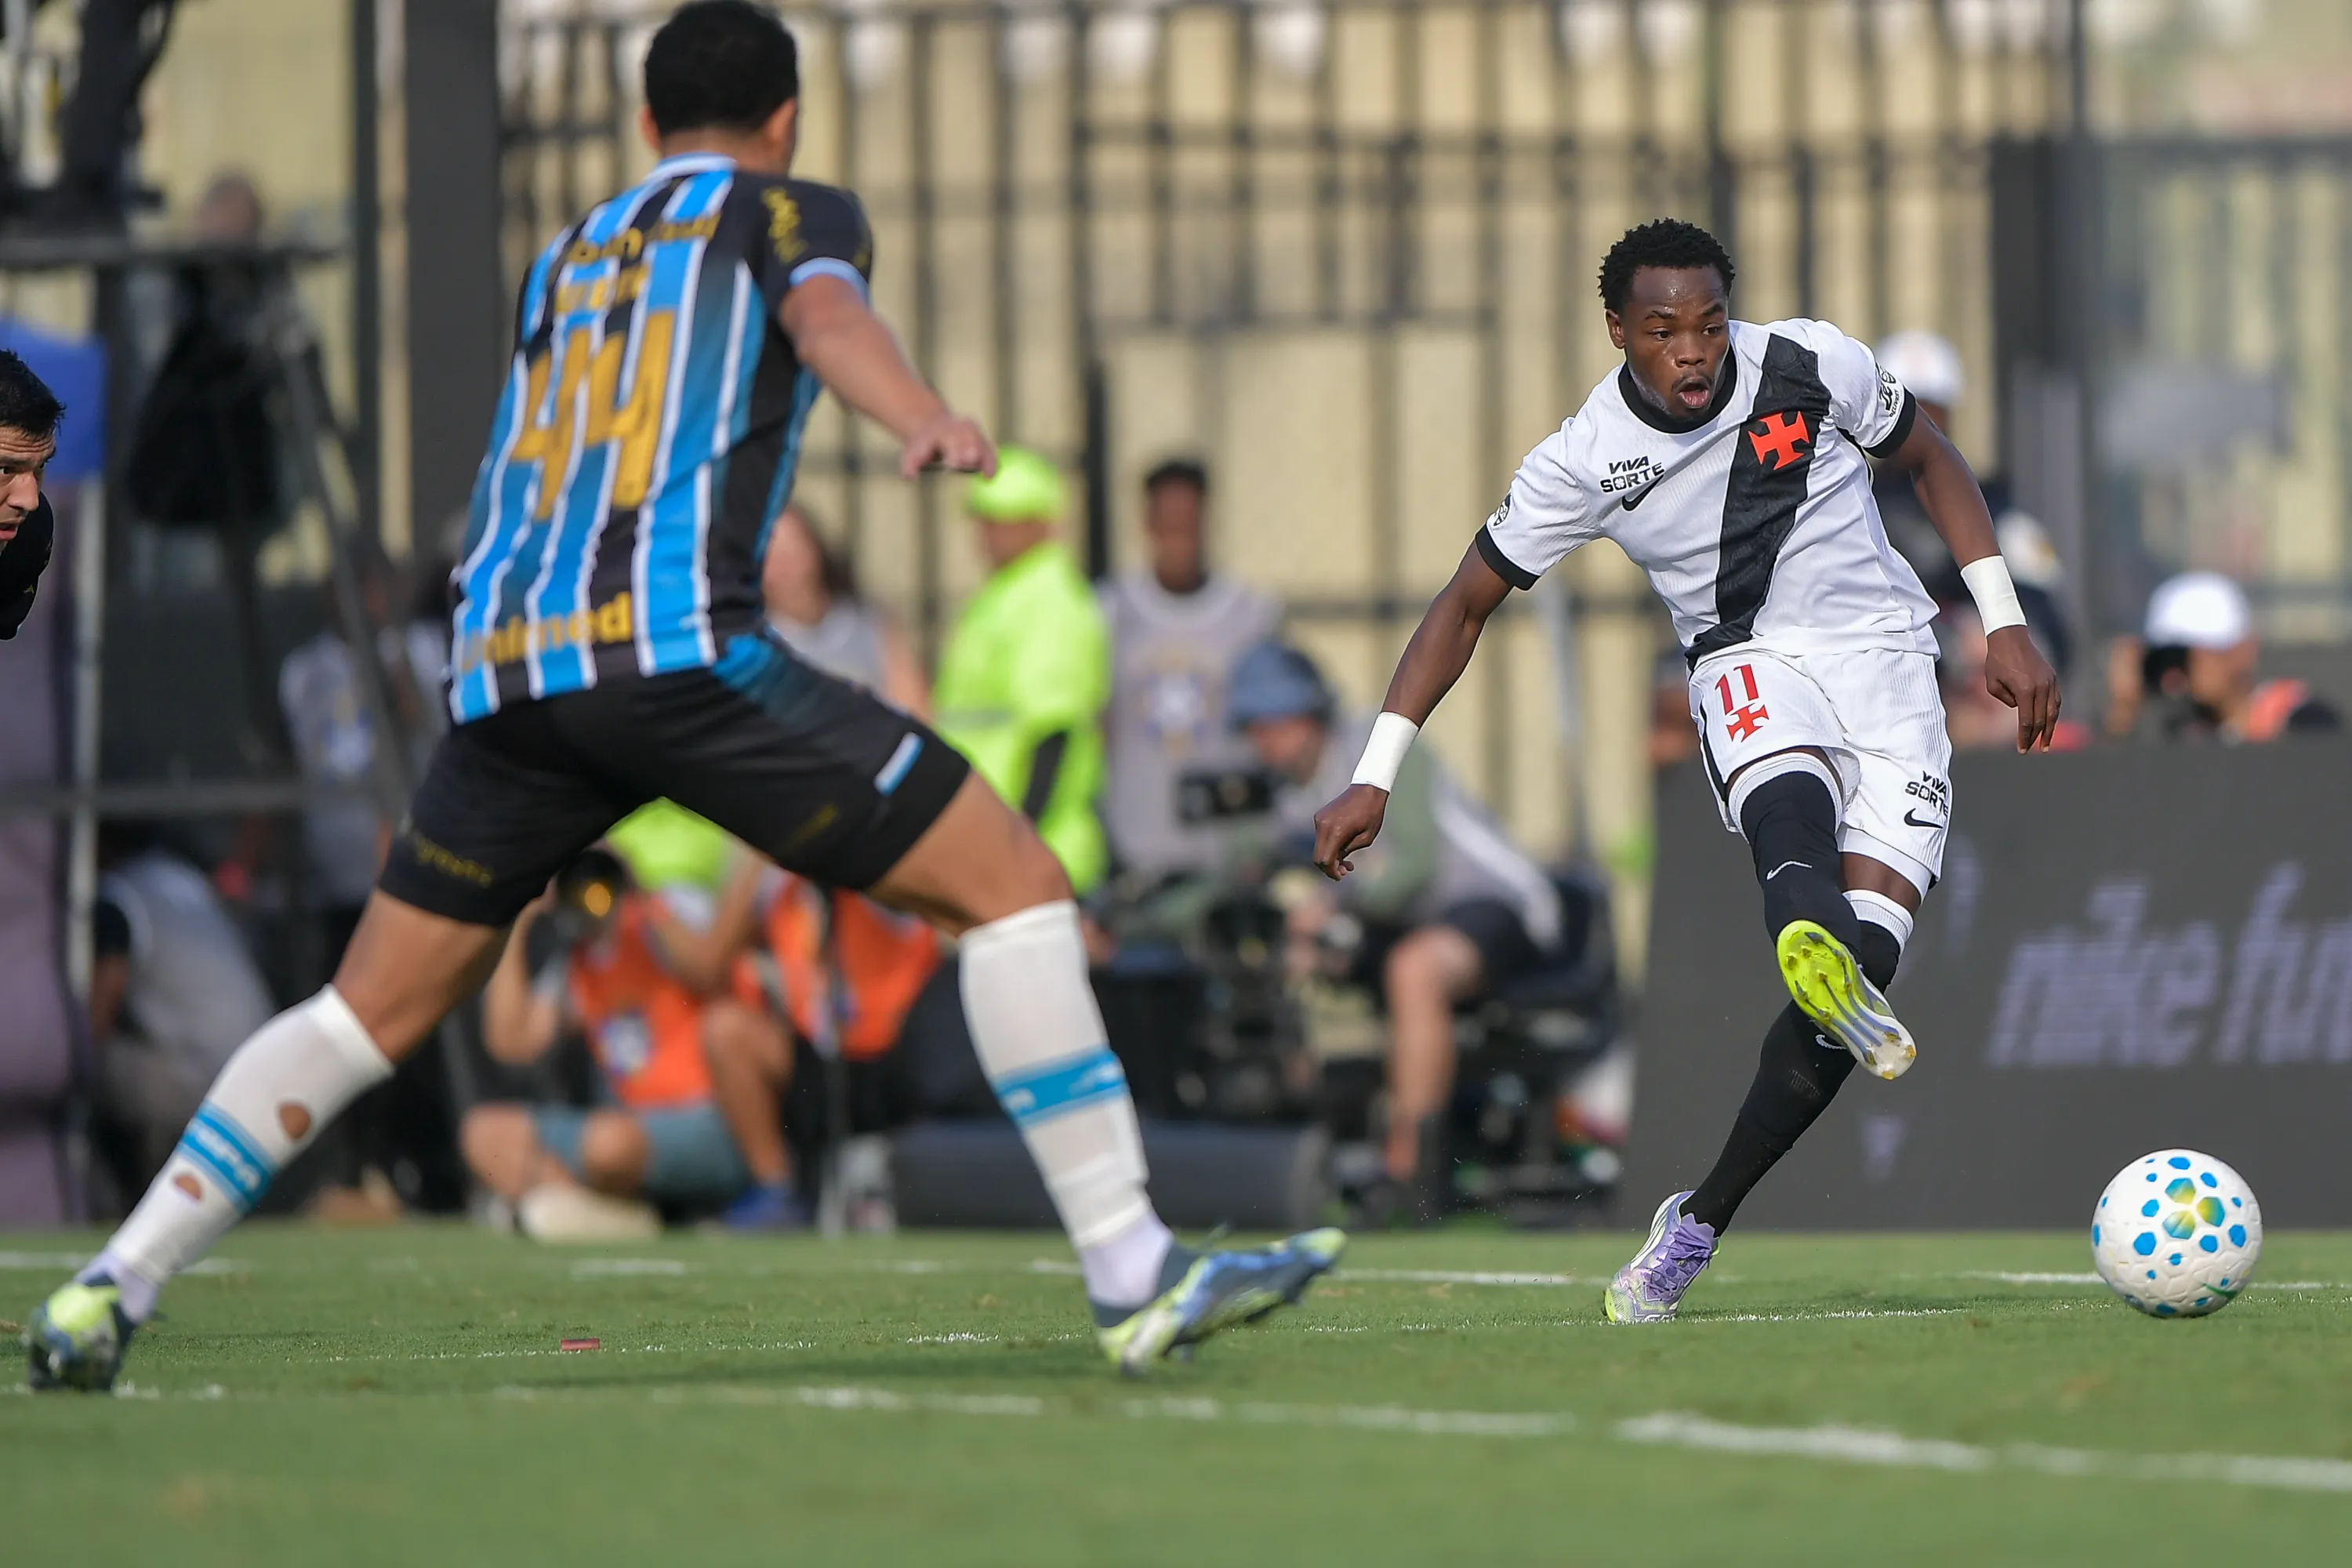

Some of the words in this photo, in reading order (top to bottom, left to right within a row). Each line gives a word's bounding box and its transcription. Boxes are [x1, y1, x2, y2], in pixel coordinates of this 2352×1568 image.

[508, 309, 677, 520] 44
[1599, 462, 1665, 493] SORTE
[1608, 455, 1650, 475] VIVA
[1714, 663, 1759, 717] 11
[1904, 781, 1949, 820] SORTE
[1922, 770, 1947, 799] VIVA
